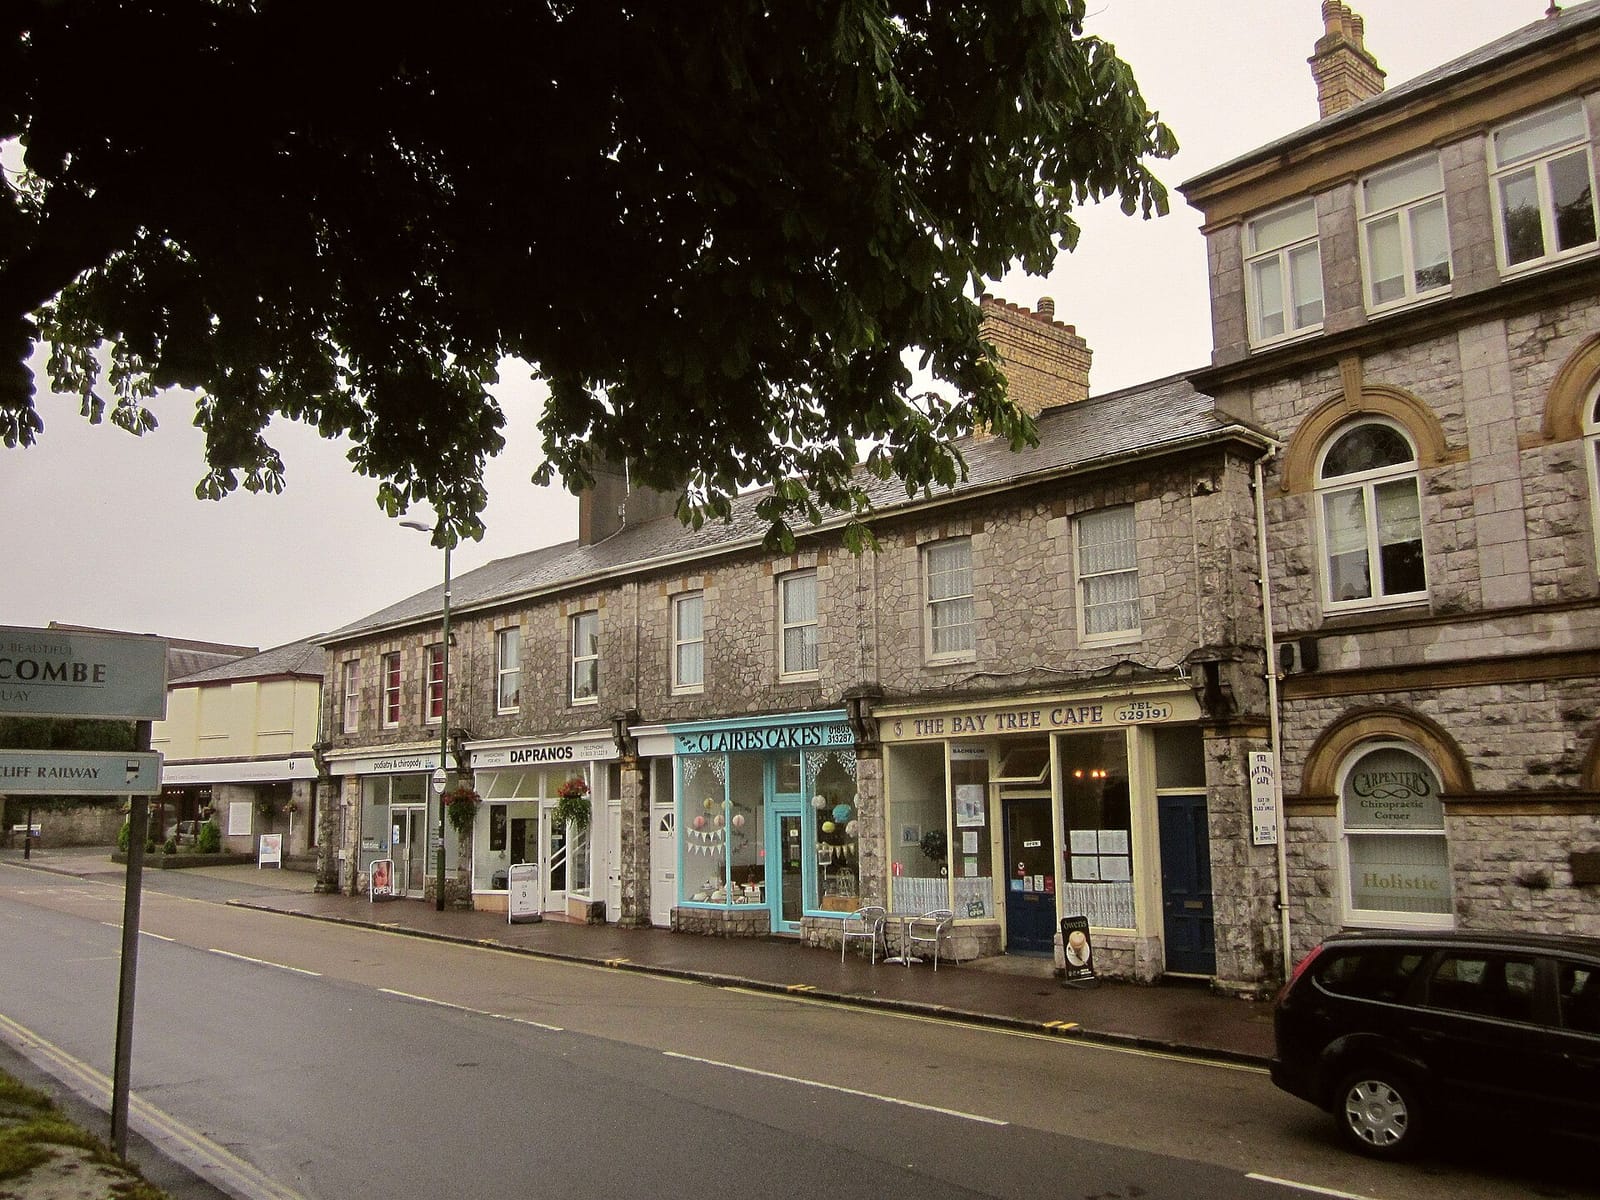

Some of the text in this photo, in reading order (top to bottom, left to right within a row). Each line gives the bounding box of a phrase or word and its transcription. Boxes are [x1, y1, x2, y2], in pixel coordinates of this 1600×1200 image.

[1129, 702, 1152, 710] TEL
[1119, 708, 1167, 720] 329191
[914, 718, 944, 736] THE
[951, 715, 987, 734] BAY
[995, 711, 1041, 731] TREE
[1050, 705, 1103, 726] CAFE
[829, 725, 850, 734] 01803
[699, 726, 821, 752] CLAIRES CAKES
[827, 734, 852, 743] 313287
[473, 754, 478, 763] 7
[510, 746, 573, 763] DAPRANOS
[373, 760, 392, 771] podiatry
[398, 758, 421, 768] chiropody
[38, 767, 100, 779] RAILWAY
[1352, 772, 1430, 797] CARPENTERS
[1360, 800, 1424, 810] Chiropractic
[1374, 811, 1410, 820] Corner
[1364, 873, 1439, 890] Holistic
[374, 886, 392, 895] OPEN
